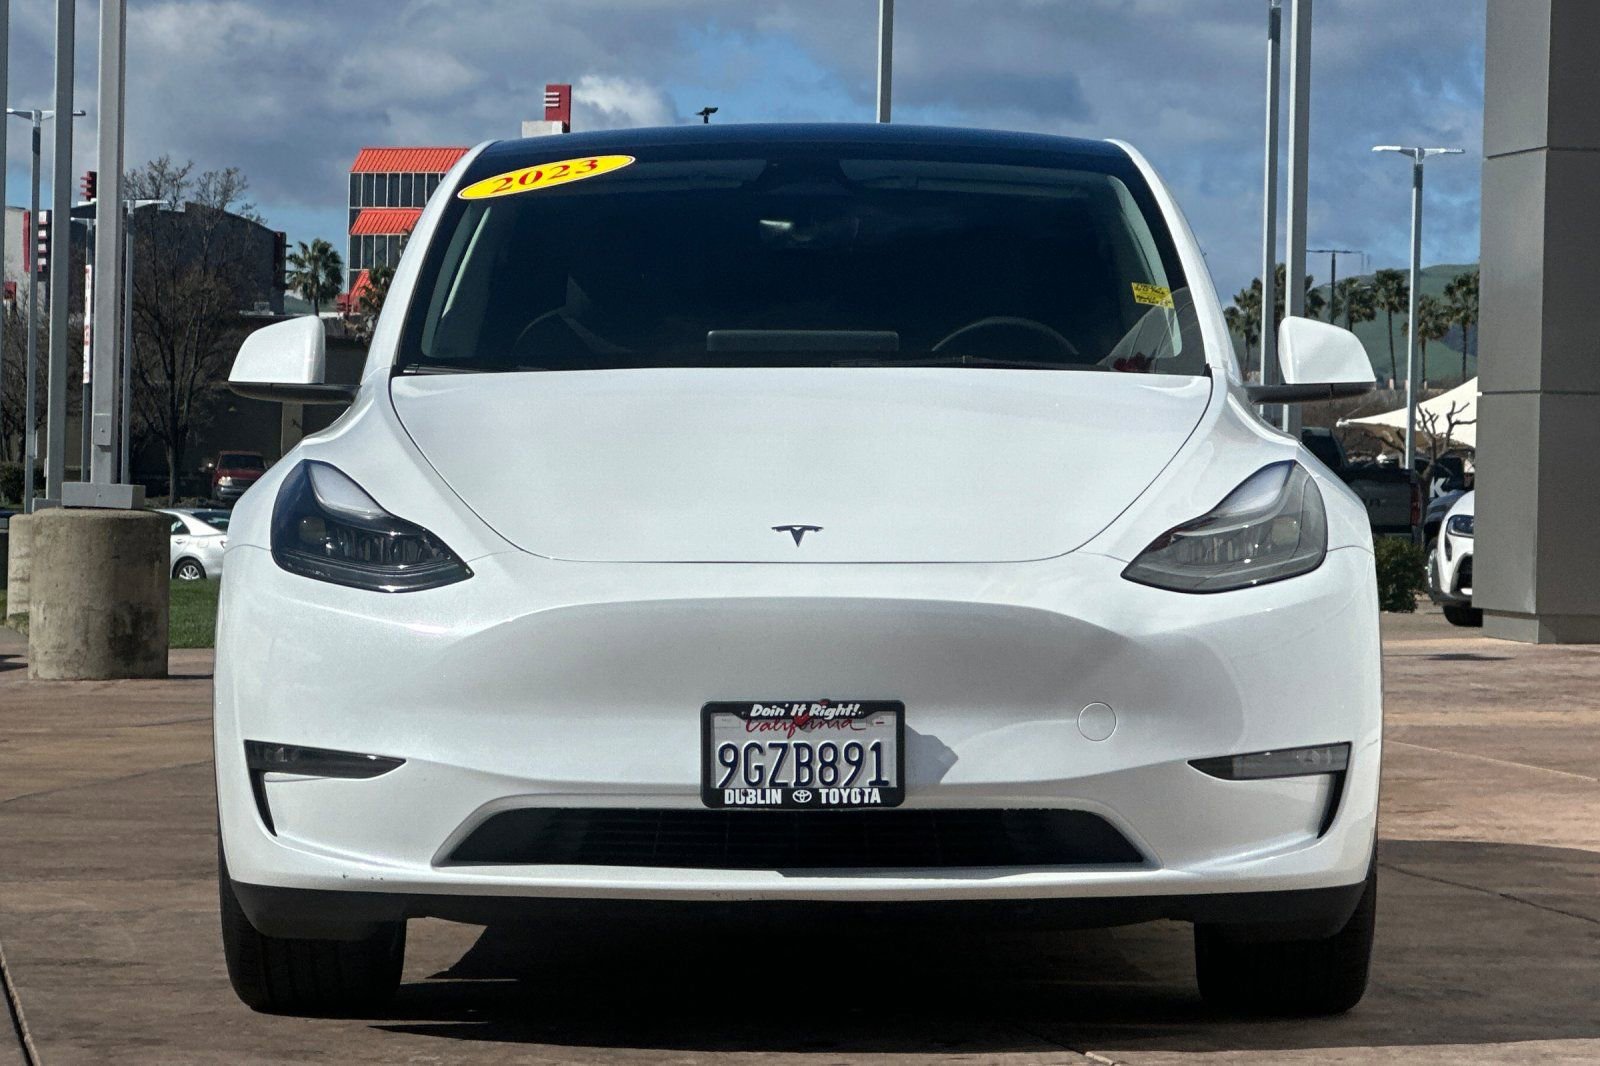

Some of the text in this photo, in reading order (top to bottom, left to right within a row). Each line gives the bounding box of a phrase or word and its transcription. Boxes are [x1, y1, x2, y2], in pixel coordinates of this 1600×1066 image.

[490, 159, 598, 194] 2023
[750, 703, 861, 720] Doin' It Right!
[718, 741, 889, 788] 9GZB891
[724, 788, 881, 804] DUBLIN TOYOTA
